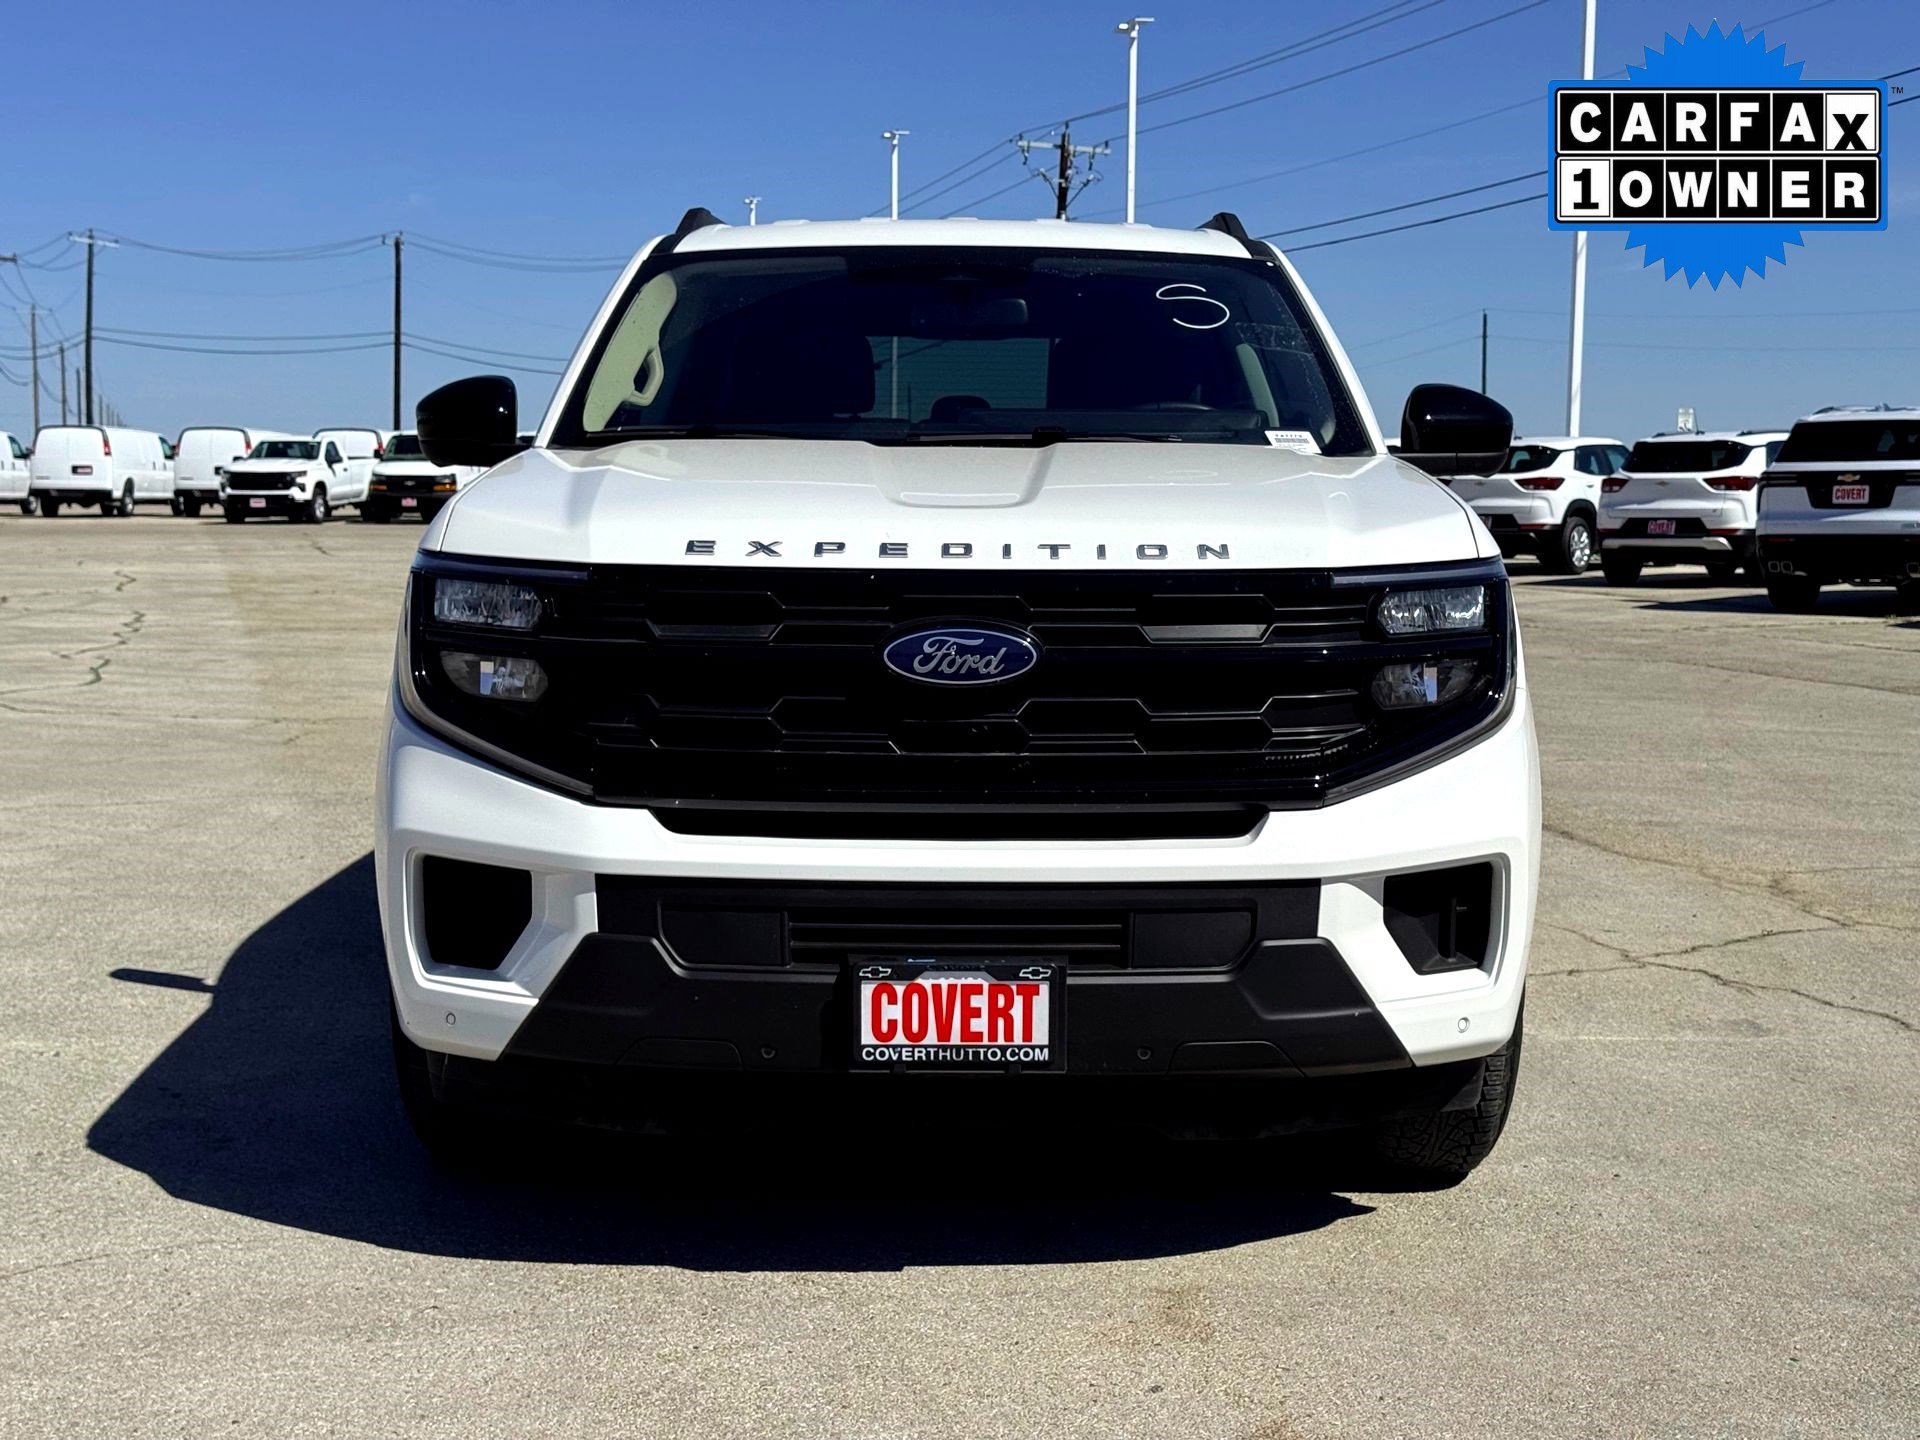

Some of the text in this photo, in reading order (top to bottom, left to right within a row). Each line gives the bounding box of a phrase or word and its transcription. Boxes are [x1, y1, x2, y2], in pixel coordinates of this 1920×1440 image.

[1835, 487, 1866, 500] COVERT
[684, 539, 1230, 560] EXPEDITION
[913, 636, 1006, 675] Ford
[871, 982, 1040, 1043] COVERT
[862, 1047, 1049, 1061] COVERTHUTTO.COM
